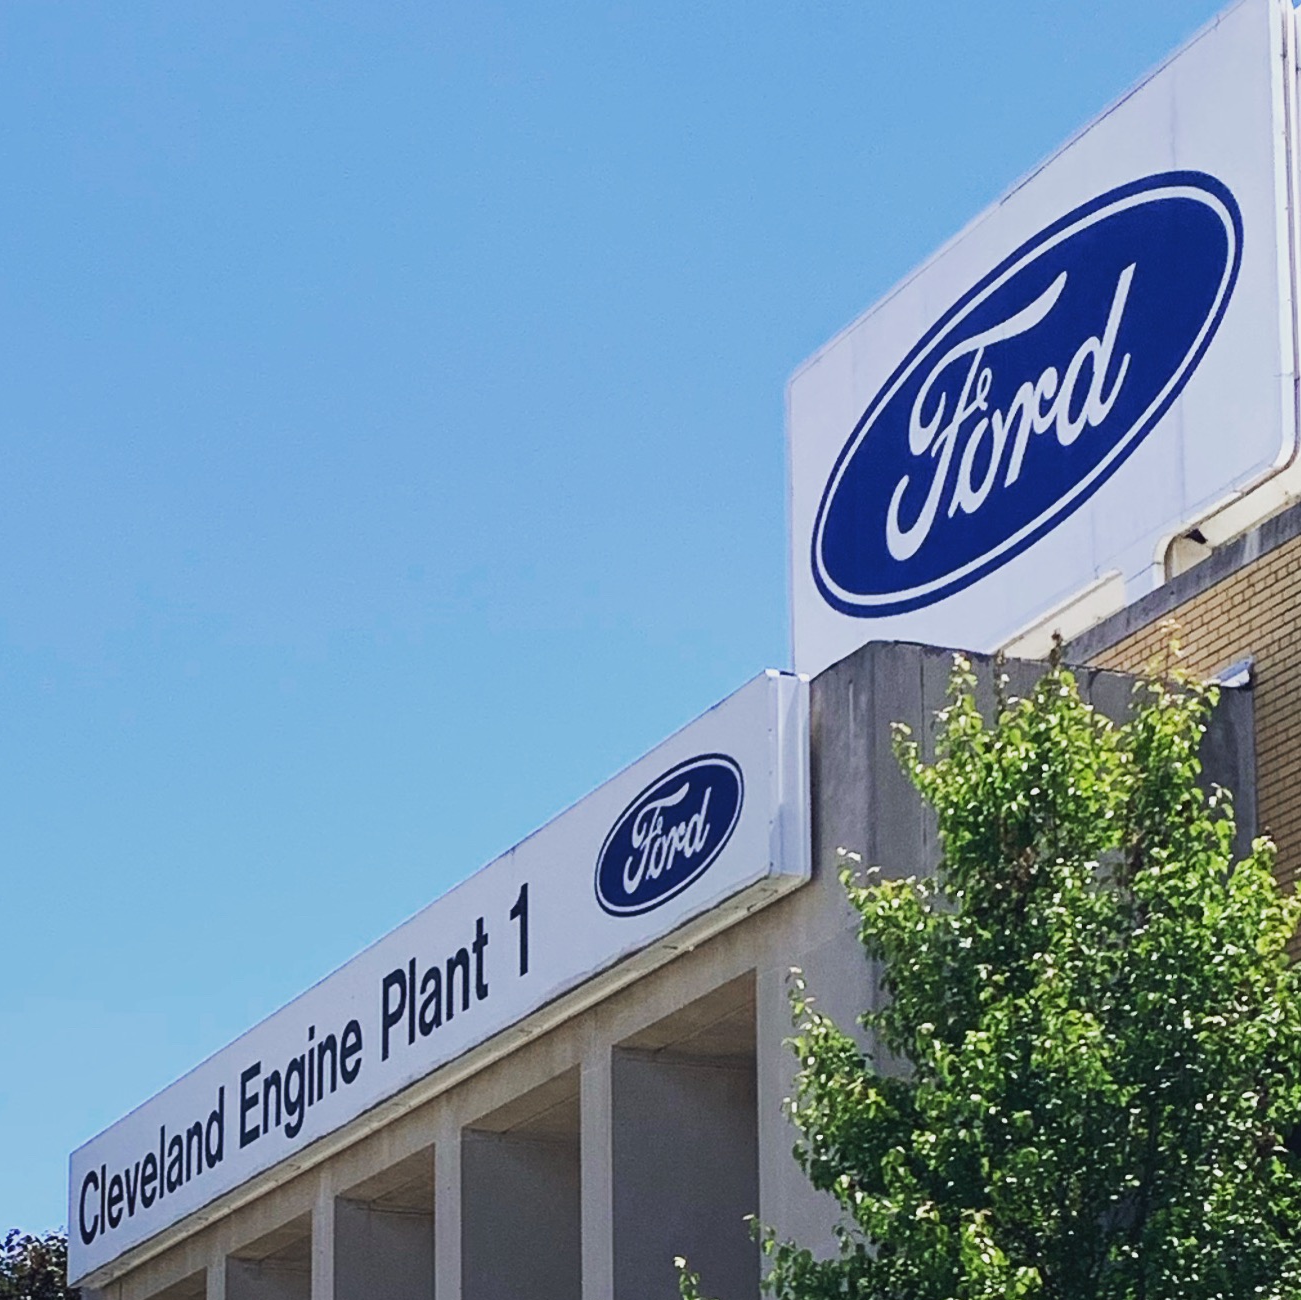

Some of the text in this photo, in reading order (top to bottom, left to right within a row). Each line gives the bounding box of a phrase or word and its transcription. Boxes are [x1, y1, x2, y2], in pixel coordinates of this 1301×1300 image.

[885, 262, 1137, 561] Ford
[623, 782, 712, 895] Ford
[78, 882, 529, 1246] Cleveland Engine Plant 1
